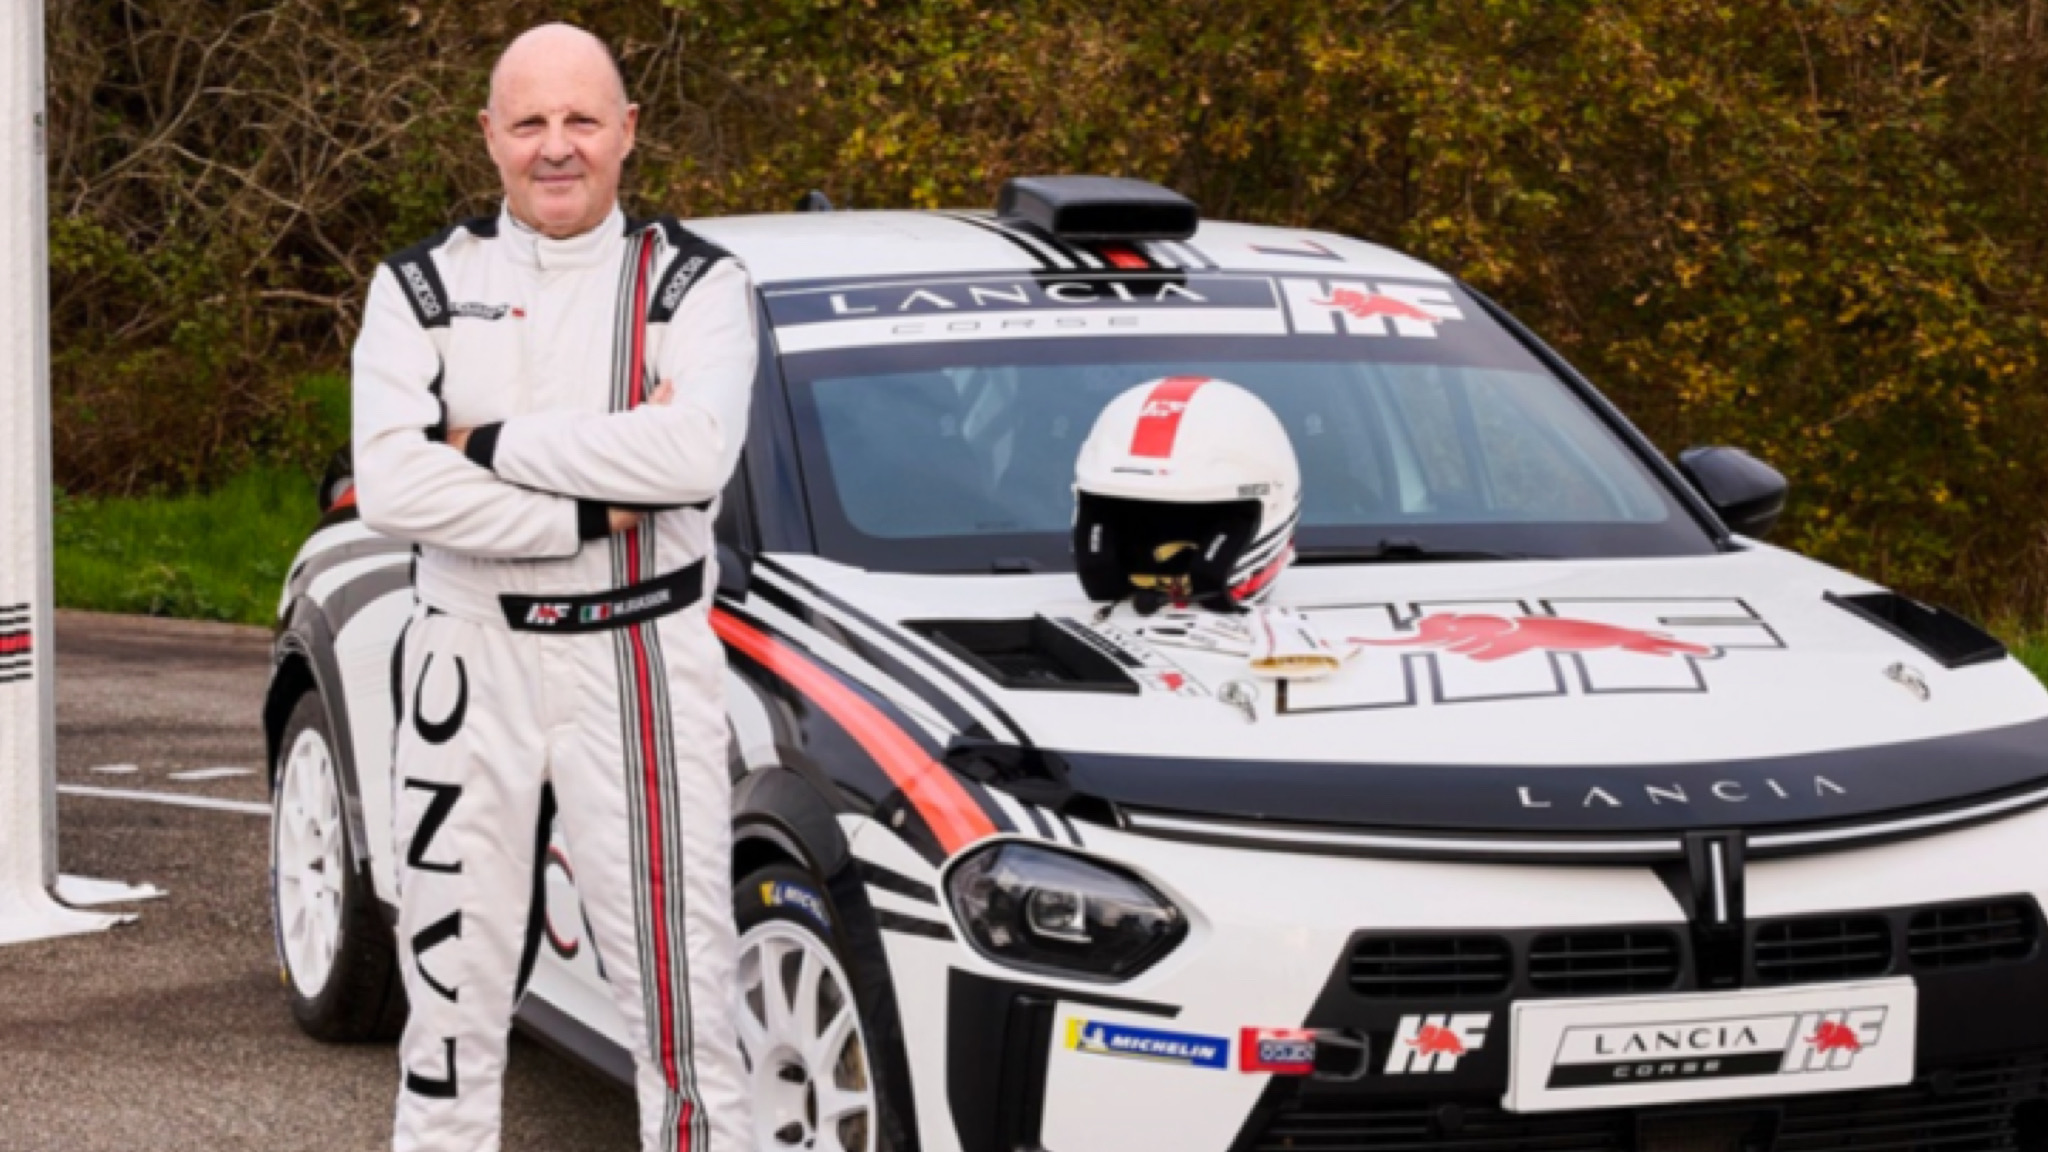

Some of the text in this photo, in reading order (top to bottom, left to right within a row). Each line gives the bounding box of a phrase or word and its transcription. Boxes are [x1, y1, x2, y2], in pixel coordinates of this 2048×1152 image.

[828, 281, 1210, 315] LANCIA
[1281, 278, 1467, 338] HF
[892, 316, 1140, 336] CORSE
[1516, 775, 1847, 808] LANCIA
[1110, 1033, 1217, 1061] MICHELIN
[1384, 1013, 1493, 1075] HF
[1594, 1025, 1759, 1055] LANCIA
[1613, 1060, 1722, 1078] CORSE
